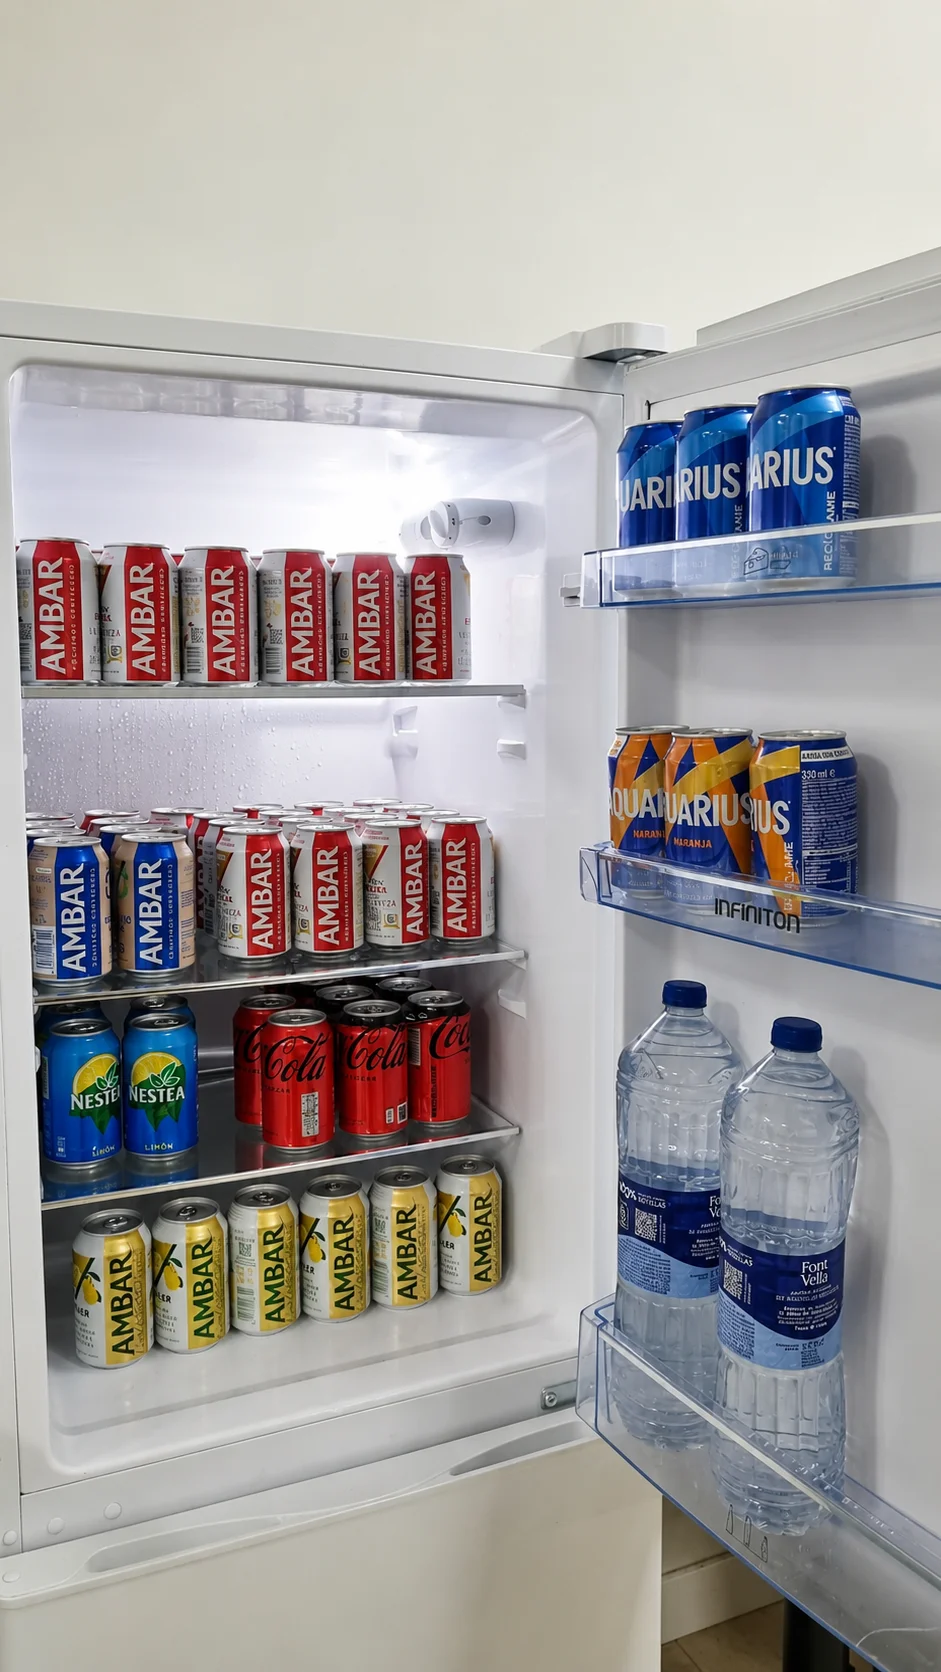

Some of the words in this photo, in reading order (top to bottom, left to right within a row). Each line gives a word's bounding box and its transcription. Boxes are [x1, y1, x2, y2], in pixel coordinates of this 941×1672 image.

[37, 556, 66, 675] AMBAR
[129, 562, 157, 676] AMBAR
[211, 565, 237, 676] AMBAR
[290, 567, 315, 677] AMBAR
[356, 569, 381, 676] AMBAR
[414, 571, 438, 676] AMBAR
[664, 792, 751, 827] UARIUS
[673, 837, 713, 848] NARANJA
[750, 798, 791, 835] IUS
[60, 863, 87, 973] AMBAR
[138, 858, 164, 966] AMBAR
[250, 846, 274, 950] AMBAR
[316, 846, 341, 946] AMBAR
[404, 840, 424, 936] AMBAR
[445, 838, 468, 933] AMBAR
[70, 1083, 120, 1110] NESTE
[129, 1085, 185, 1103] NESTEA
[265, 1032, 330, 1082] Cola
[191, 1228, 215, 1339] AMBAR
[263, 1215, 285, 1323] AMBAR
[333, 1206, 355, 1311] AMBAR
[395, 1197, 418, 1300] AMBAR
[474, 1182, 493, 1283] AMBAR
[800, 1272, 829, 1287] Vella
[802, 1259, 829, 1274] Font
[109, 1241, 136, 1356] AMBAR
